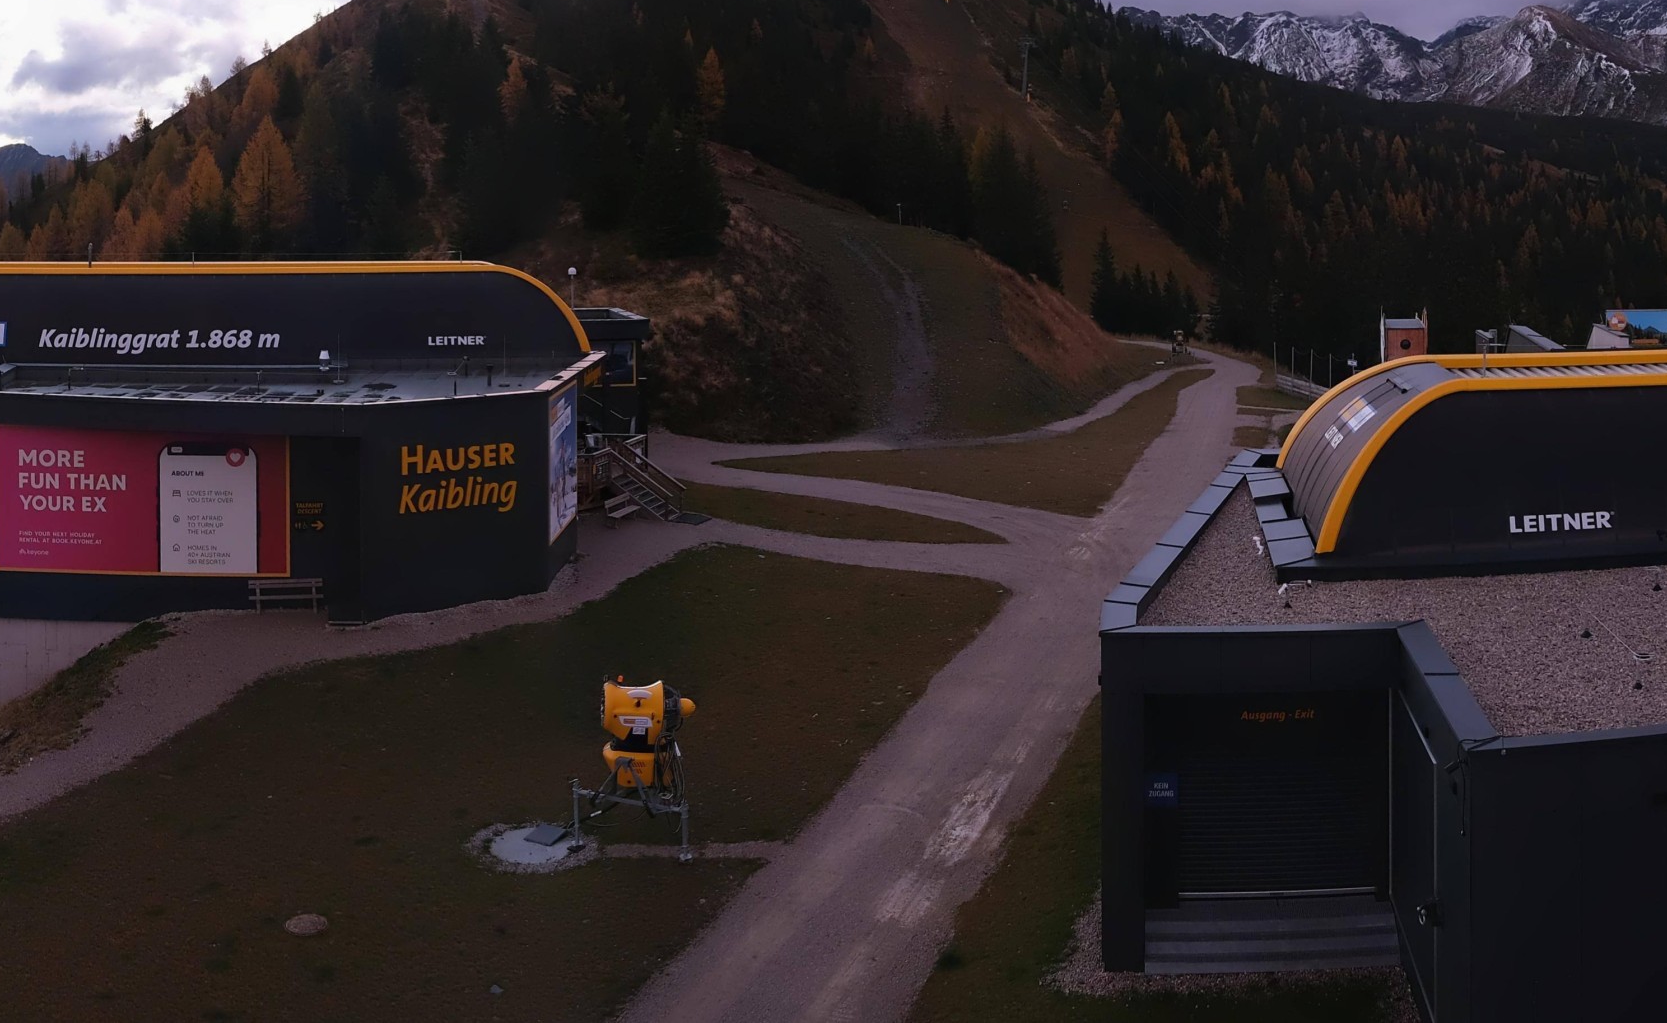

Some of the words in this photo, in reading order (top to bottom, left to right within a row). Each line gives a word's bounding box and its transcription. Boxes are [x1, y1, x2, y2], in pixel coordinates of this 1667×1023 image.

[38, 328, 180, 355] Kaiblinggrat
[185, 329, 253, 349] 1.868
[258, 333, 281, 349] m
[427, 336, 485, 346] LEITNER
[18, 449, 85, 467] MORE
[400, 442, 516, 475] HAUSER
[18, 472, 60, 489] FUN
[66, 473, 127, 491] THAN
[19, 495, 75, 511] YOUR
[81, 496, 107, 512] EX
[399, 476, 518, 514] Kaibling
[1509, 511, 1613, 533] LEITNER
[1241, 710, 1286, 723] Ausgang
[1295, 708, 1316, 719] Exit
